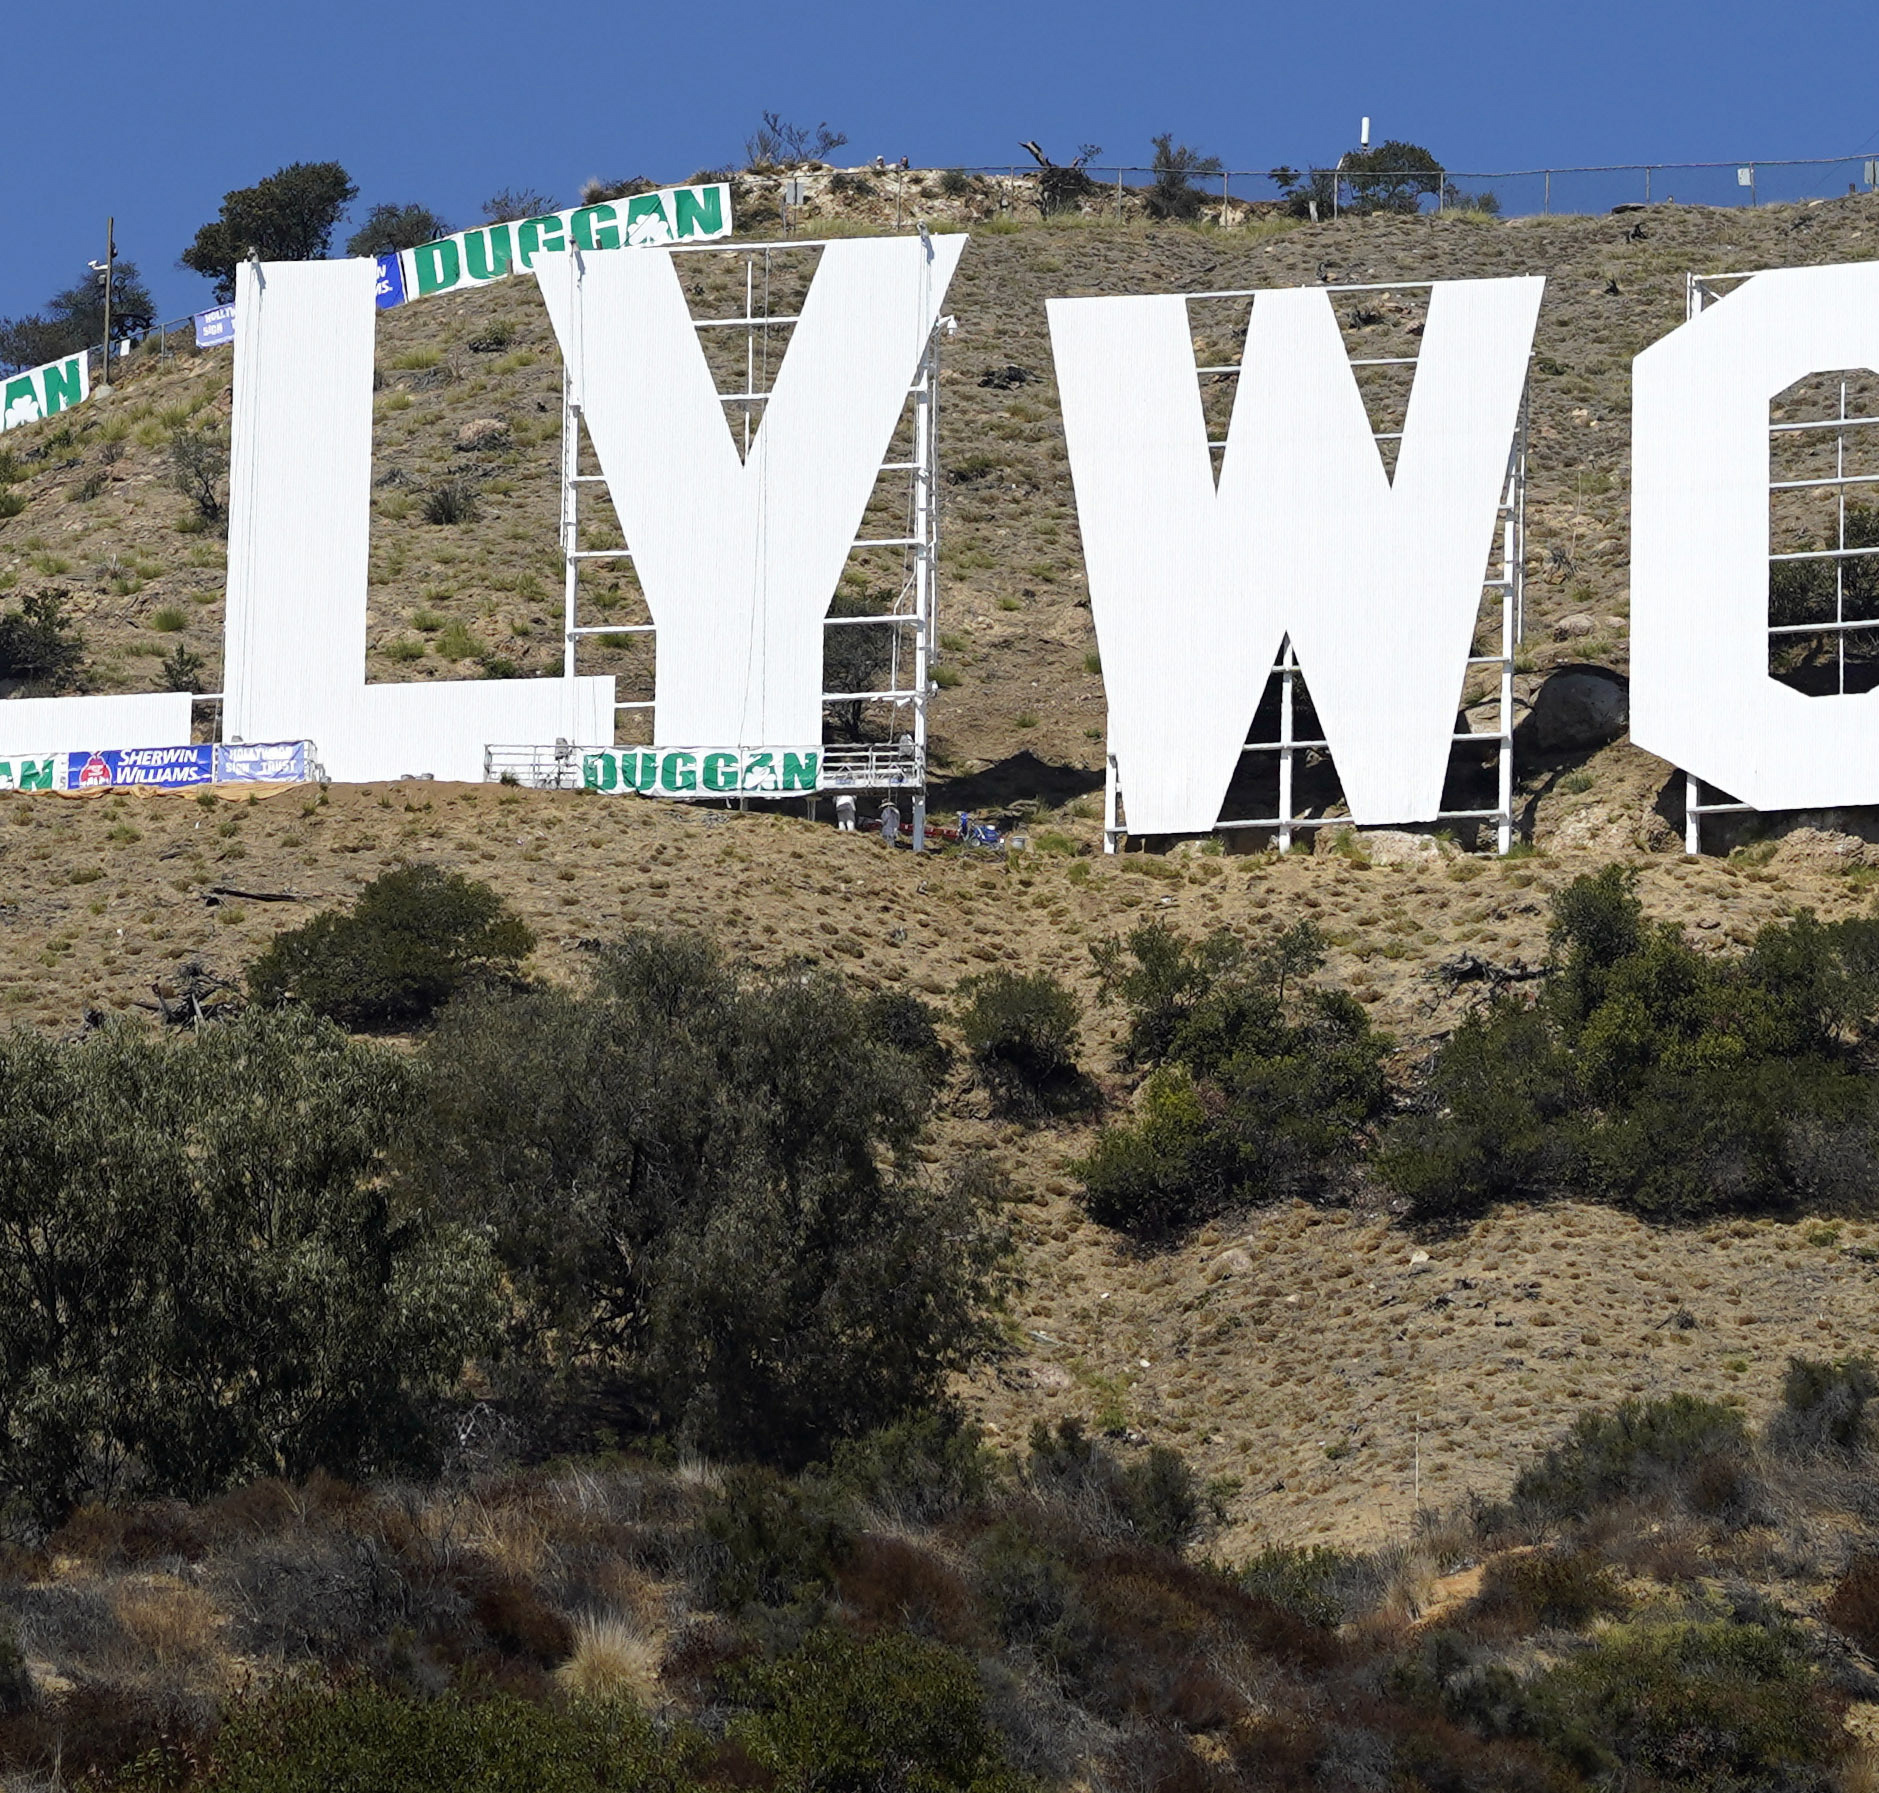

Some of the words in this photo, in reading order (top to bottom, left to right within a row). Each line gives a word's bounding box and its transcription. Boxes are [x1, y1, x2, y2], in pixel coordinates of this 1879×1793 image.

[413, 187, 724, 296] DUGGAN
[117, 748, 198, 766] SHERWIN
[229, 746, 294, 762] HOLLYWOOD
[224, 761, 251, 775] SIGN
[260, 760, 297, 776] TRUST
[583, 753, 819, 793] DUGGAN
